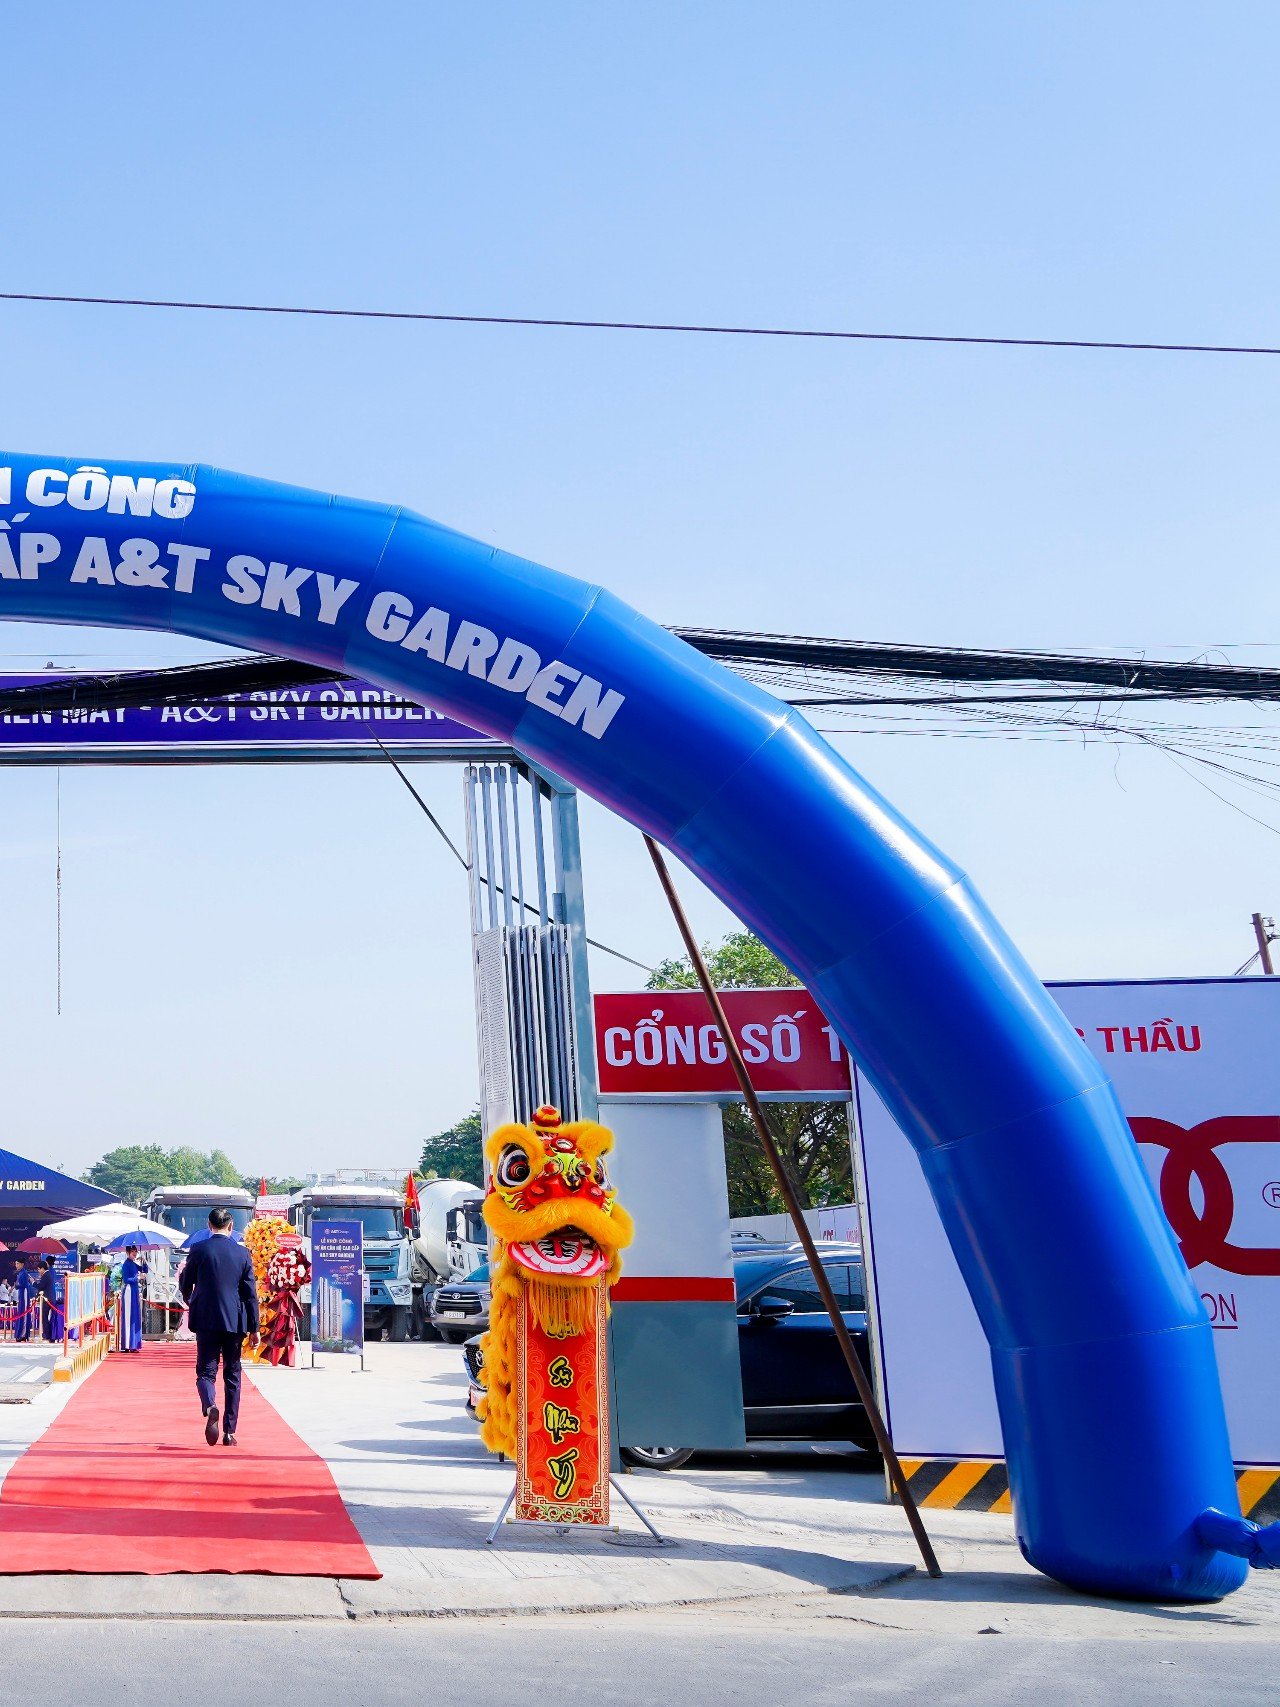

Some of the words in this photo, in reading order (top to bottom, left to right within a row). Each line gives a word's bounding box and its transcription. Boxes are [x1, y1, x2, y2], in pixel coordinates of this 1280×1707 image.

[24, 465, 197, 520] CÔNG
[69, 534, 212, 595] A&T
[220, 553, 361, 628] SKY
[364, 589, 626, 742] GARDEN
[249, 690, 311, 721] SKY
[605, 1009, 726, 1066] CỔNG
[742, 1010, 808, 1065] SỐ
[1096, 1017, 1201, 1053] THẦU
[6, 1180, 45, 1191] GARDEN
